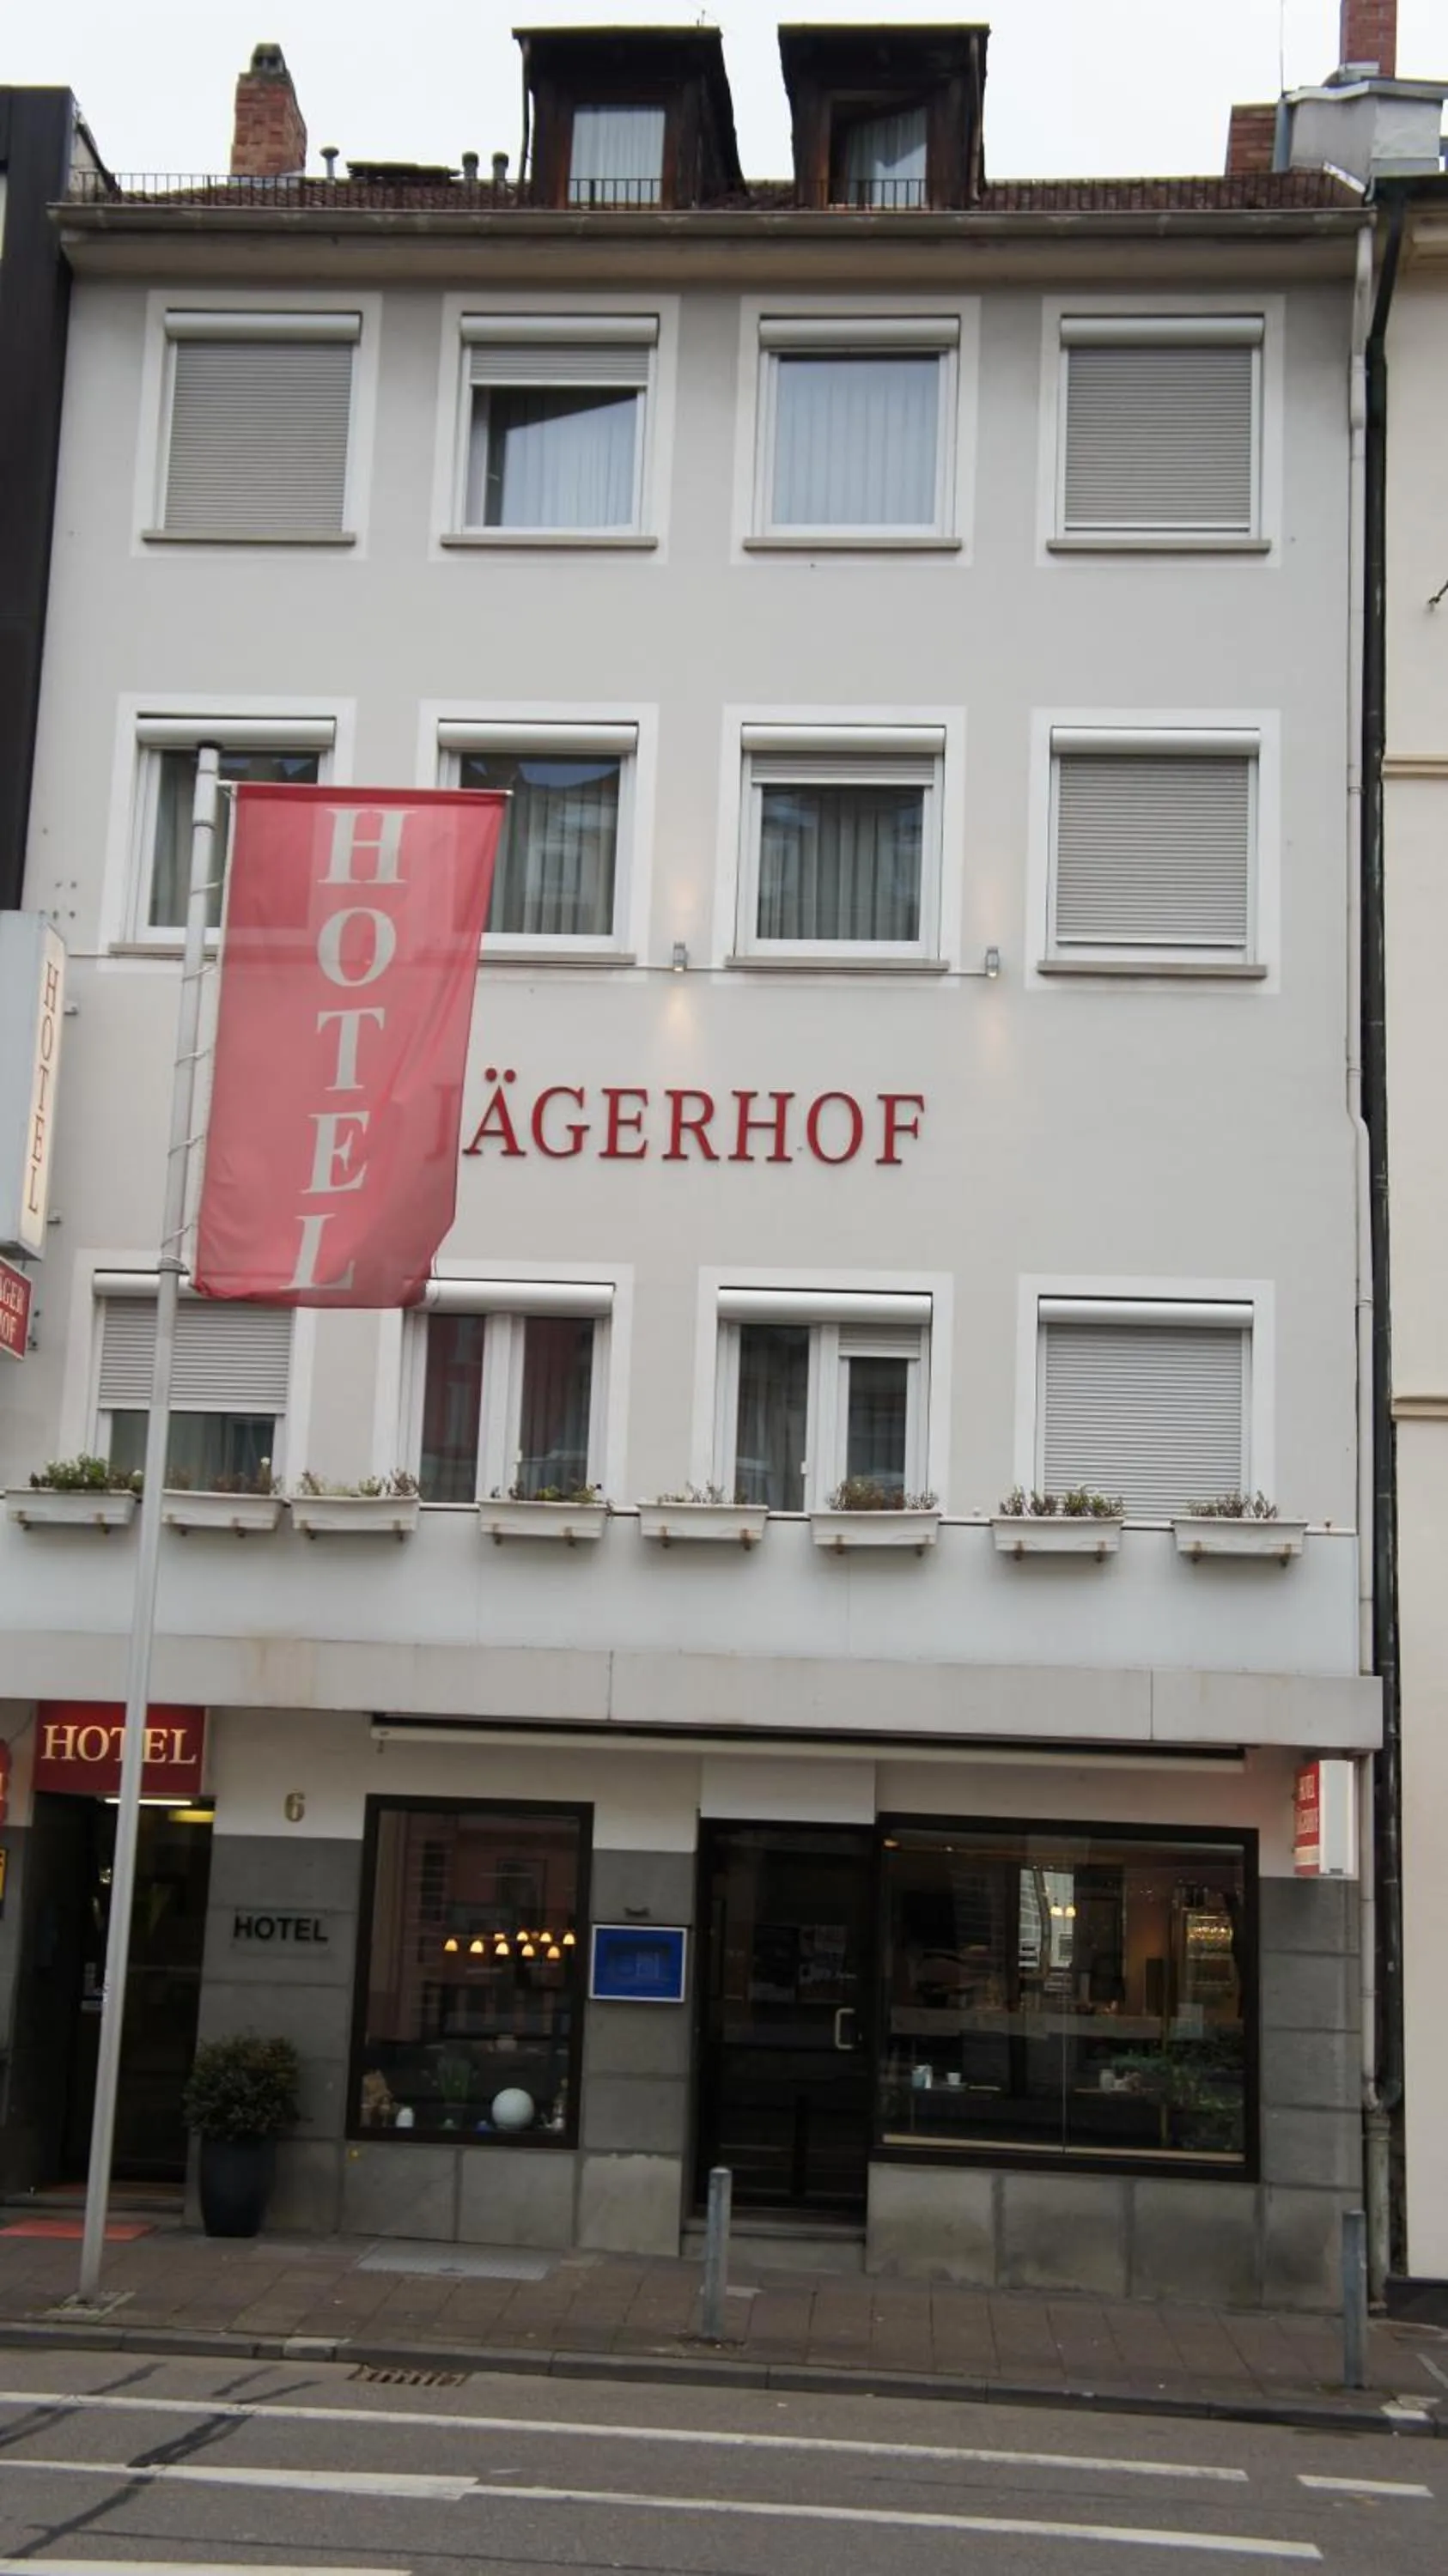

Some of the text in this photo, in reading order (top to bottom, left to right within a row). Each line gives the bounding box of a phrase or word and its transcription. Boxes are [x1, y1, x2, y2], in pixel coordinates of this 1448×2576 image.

[27, 961, 59, 1214] HOTEL
[279, 809, 416, 1291] HOTEL
[284, 1792, 305, 1822] 6
[234, 1916, 328, 1941] HOTEL
